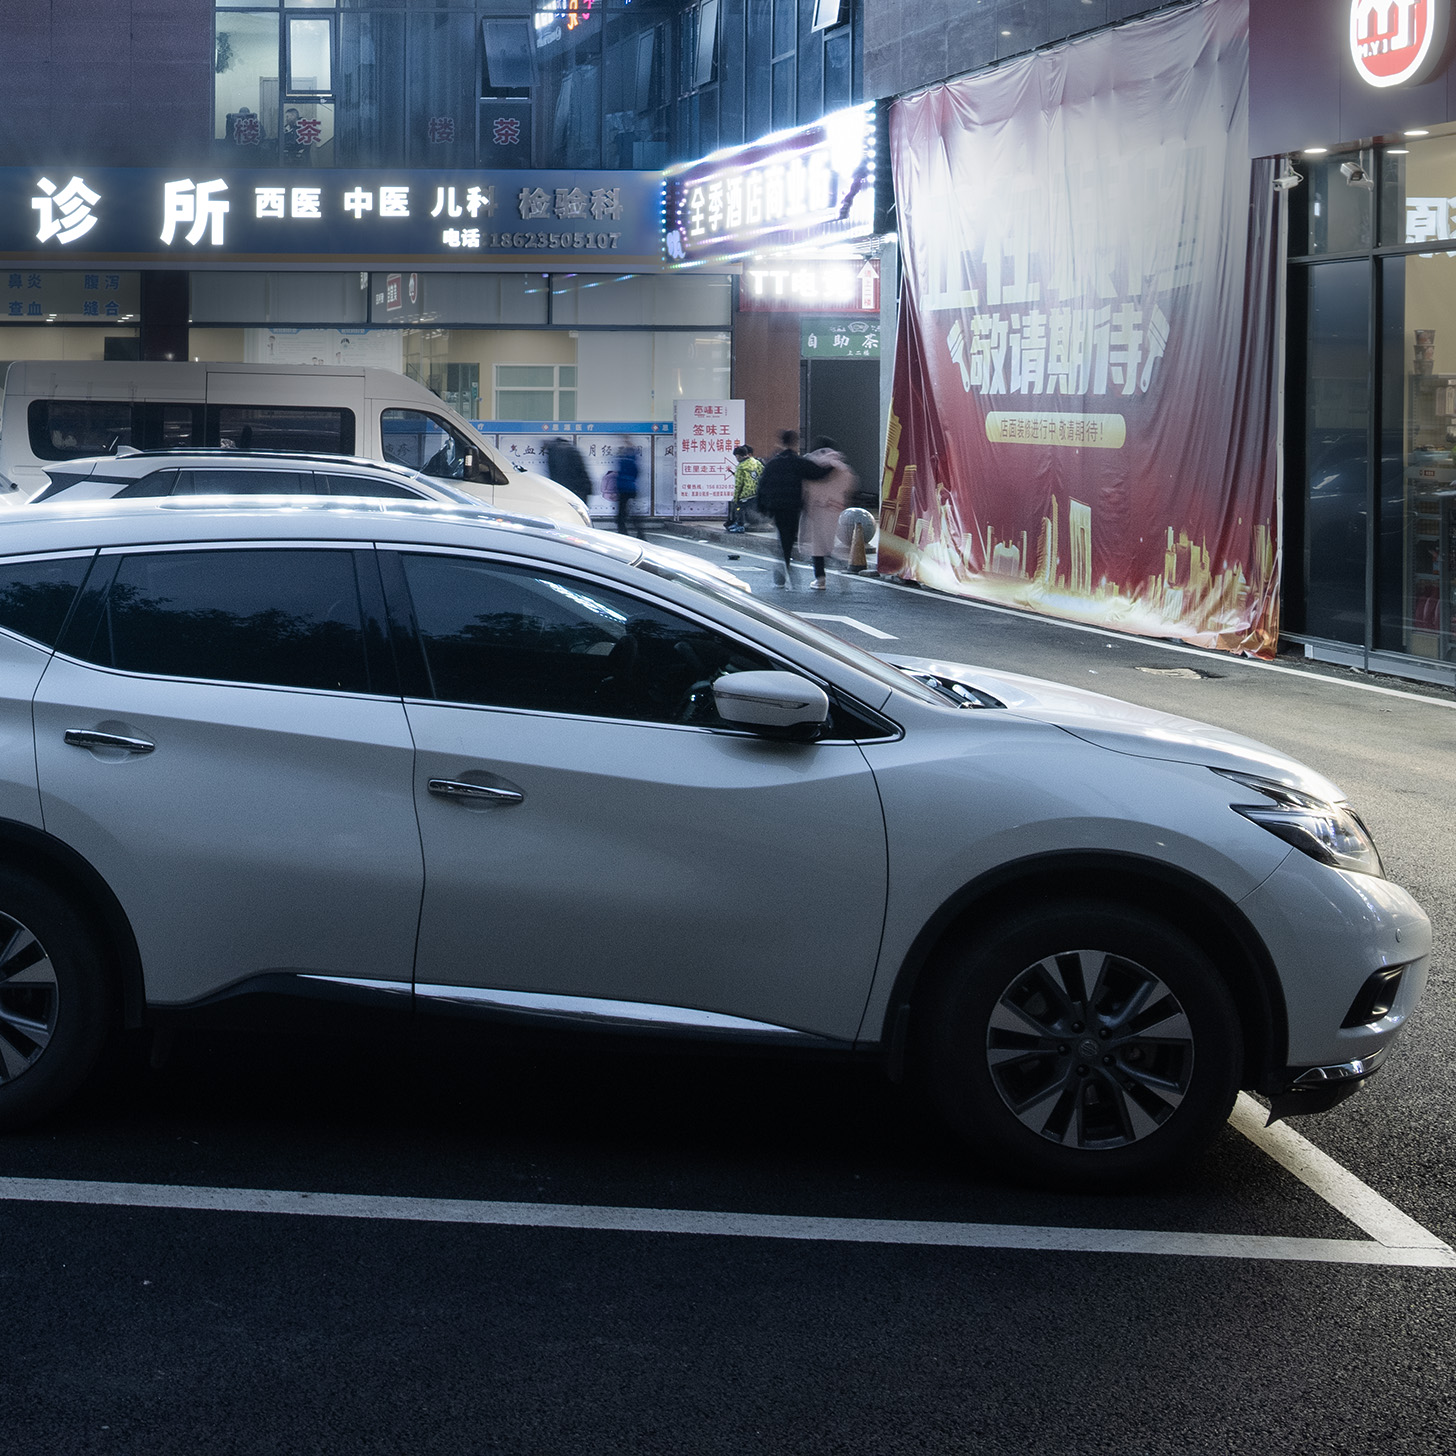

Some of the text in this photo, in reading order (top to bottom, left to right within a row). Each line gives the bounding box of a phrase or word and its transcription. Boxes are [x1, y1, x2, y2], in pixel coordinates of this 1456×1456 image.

[295, 117, 322, 145] 茶
[493, 118, 520, 145] 茶
[255, 187, 622, 221] 西医 中医 儿科 检验科
[8, 273, 42, 290] 鼻炎
[83, 273, 120, 290] 腹泻
[8, 300, 43, 318] 查血
[83, 300, 120, 318] 缝合
[969, 303, 1142, 395] 敬请期待
[693, 424, 730, 435] 签味王
